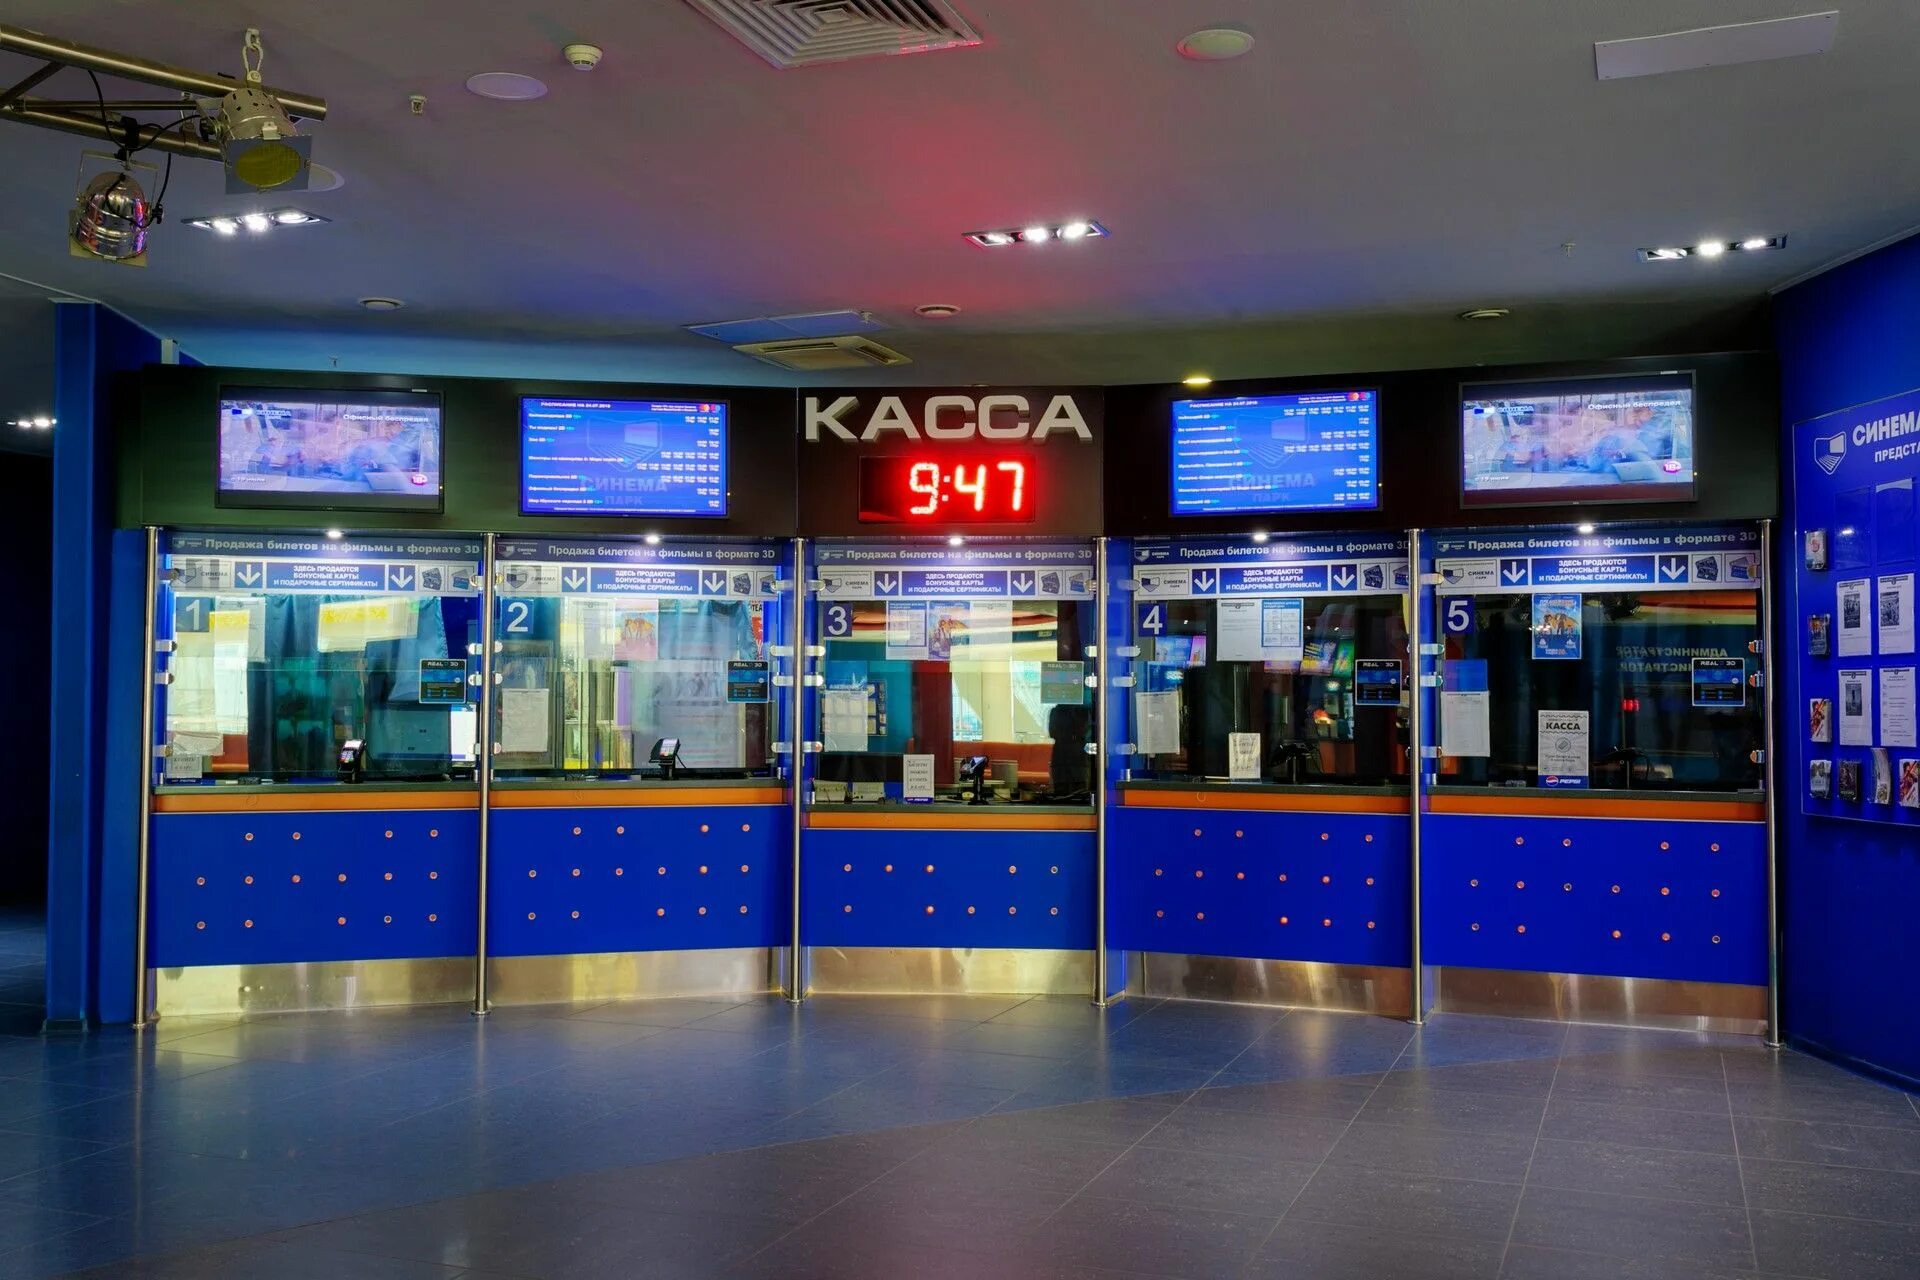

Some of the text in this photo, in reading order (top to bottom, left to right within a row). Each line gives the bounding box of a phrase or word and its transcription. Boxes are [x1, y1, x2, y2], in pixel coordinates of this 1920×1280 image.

[805, 395, 1093, 441] КАССА
[909, 461, 1025, 515] 9:47
[1468, 540, 1524, 551] Продажа
[1528, 539, 1580, 548] билетов
[1603, 537, 1659, 548] фильмы
[1675, 533, 1735, 545] формате
[1740, 531, 1757, 540] 3D
[205, 539, 263, 550] Продажа
[267, 540, 318, 550] билетов
[341, 542, 393, 553] фильмы
[407, 543, 461, 554] формате
[464, 545, 480, 554] 3D
[1180, 548, 1224, 558] Продажа
[1227, 546, 1269, 555] билетов
[1288, 544, 1334, 554] фильмы
[1345, 542, 1394, 553] формате
[548, 545, 595, 556] Продажа
[598, 547, 640, 556] билетов
[658, 548, 703, 558] фильмы
[706, 550, 713, 558] в
[715, 549, 760, 560] формате
[762, 550, 775, 558] 3D
[846, 550, 897, 560] Продажа
[900, 550, 944, 558] билетов
[964, 550, 1012, 560] фильмы
[1024, 550, 1075, 560] формате
[1078, 550, 1092, 558] 3D
[1583, 558, 1627, 566] ПРОДАЮТСЯ
[293, 565, 359, 573] ЗДЕСЬ ПРОДАЮТСЯ
[1264, 568, 1303, 576] ПРОДАЮТСЯ
[1559, 565, 1627, 574] БОНУСНЫЕ КАРТЫ
[334, 572, 359, 580] КАРТЫ
[615, 576, 650, 584] БОНУСНЫЕ
[1243, 575, 1279, 583] БОНУСНЫЕ
[1545, 574, 1593, 582] ПОДАРОЧНЫЕ
[1594, 573, 1647, 581] СЕРТИФИКАТЫ
[280, 579, 326, 587] ПОДАРОЧНЫЕ
[328, 579, 378, 587] СЕРТИФИКАТЫ
[1231, 583, 1273, 591] ПОДАРОЧНЫЕ
[1274, 582, 1321, 590] СЕРТИФИКАТЫ
[185, 599, 200, 630] 1
[506, 602, 529, 632] 2
[1447, 600, 1470, 631] 5
[827, 605, 848, 635] 3
[1142, 605, 1162, 635] 4
[1545, 722, 1581, 730] КАССА
